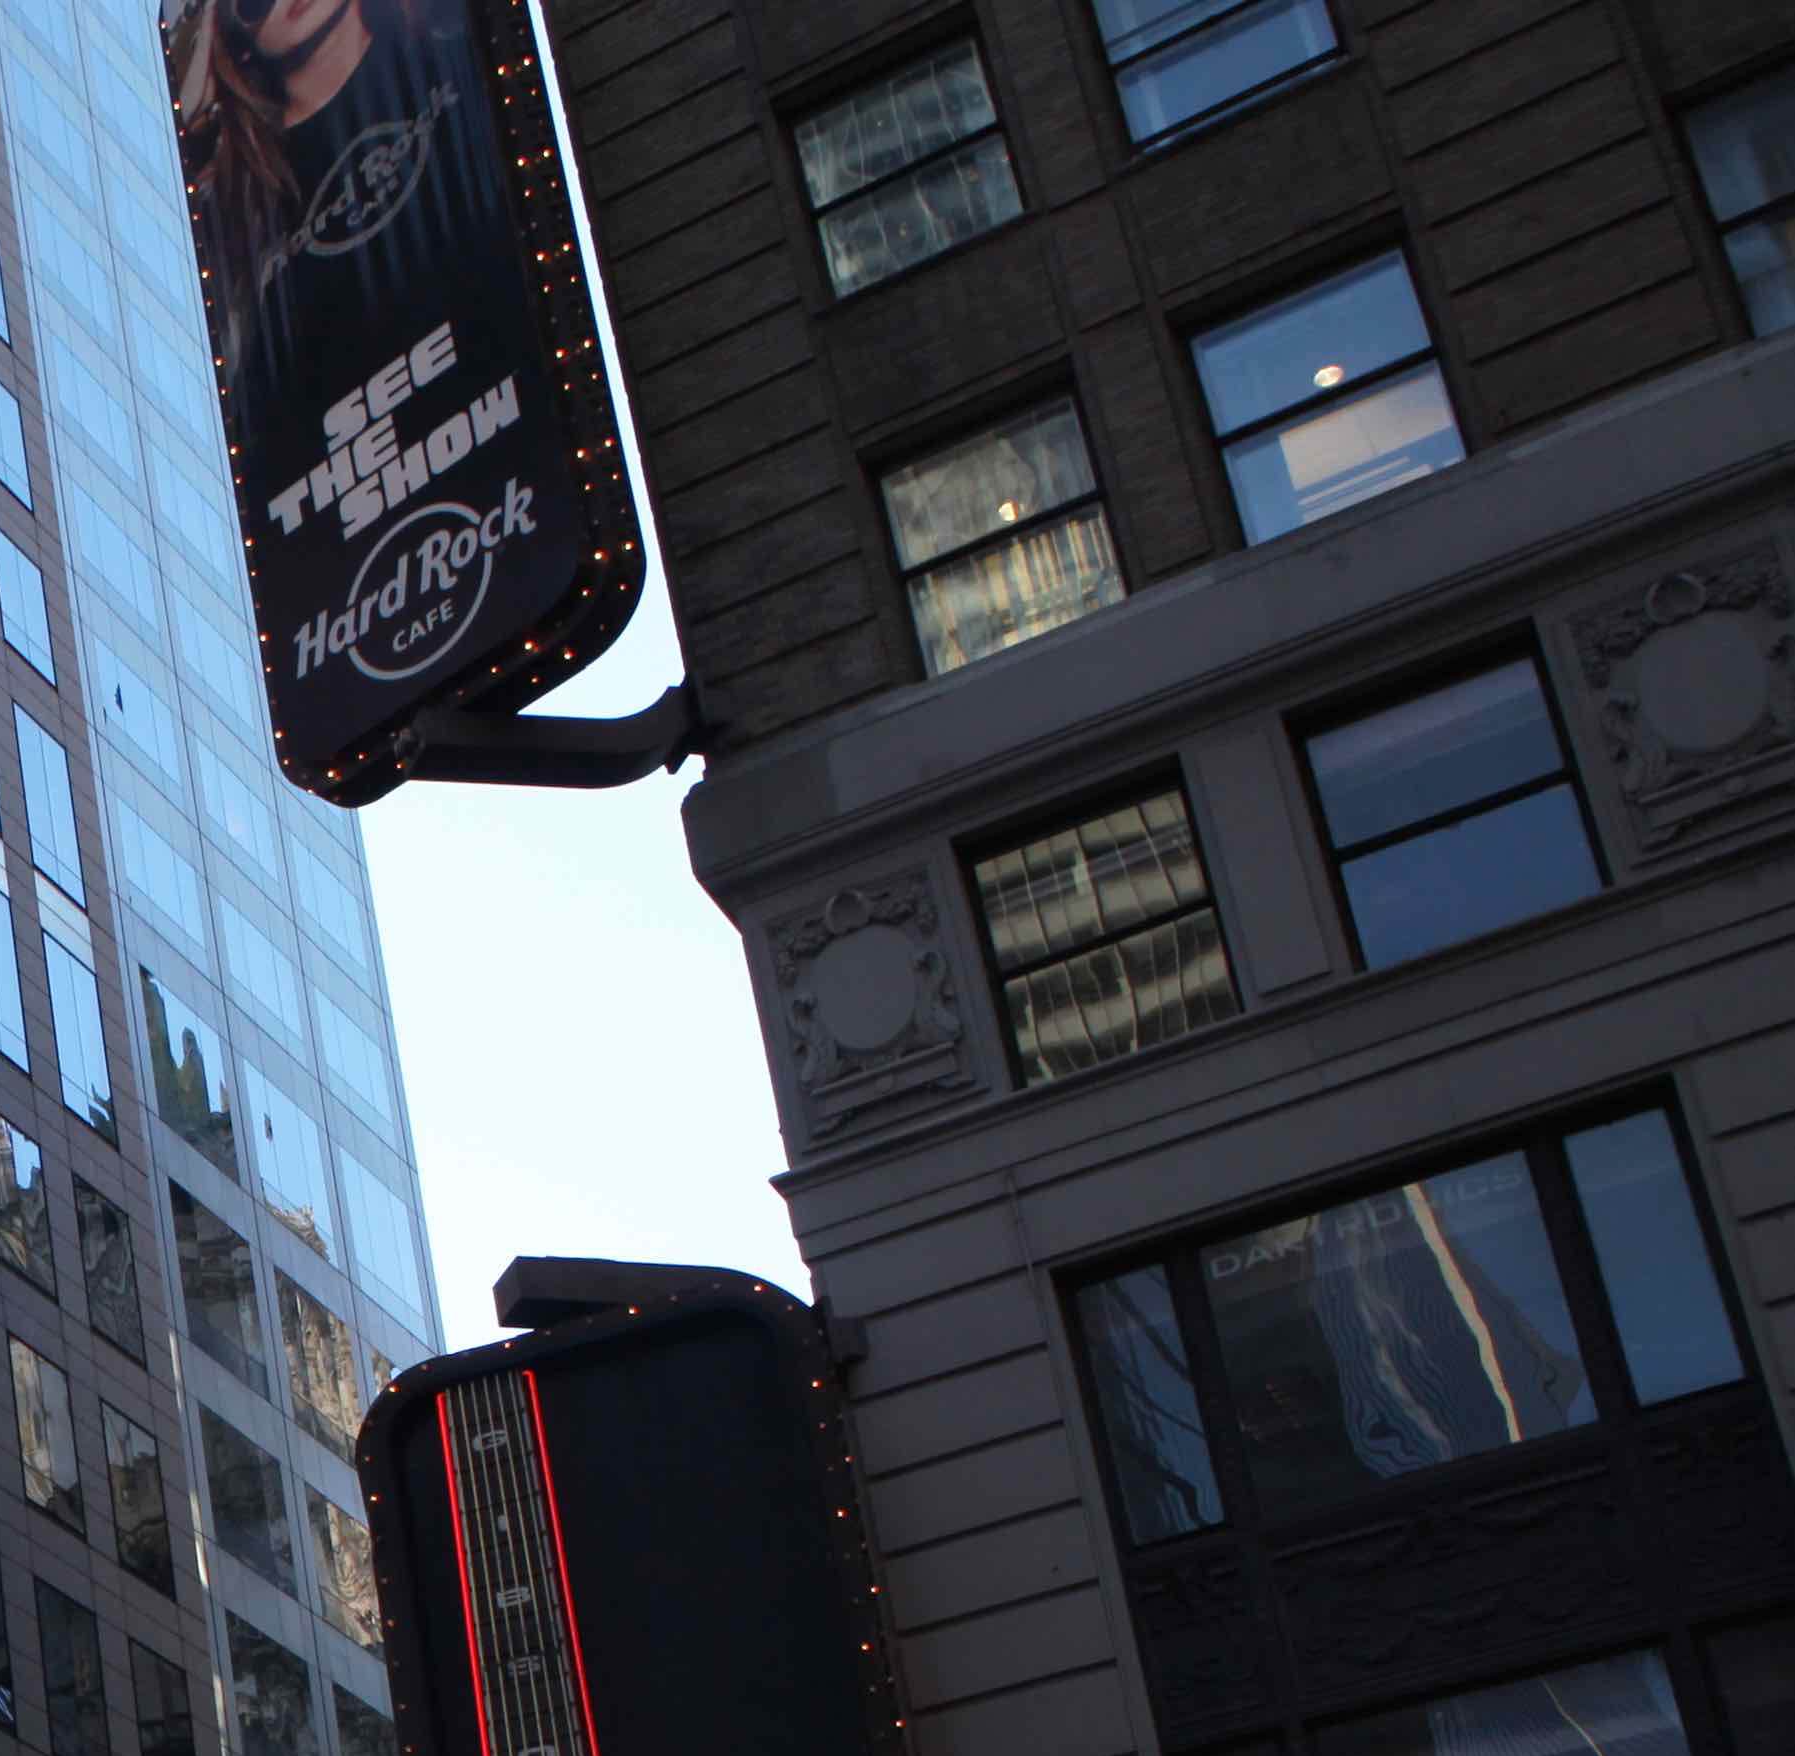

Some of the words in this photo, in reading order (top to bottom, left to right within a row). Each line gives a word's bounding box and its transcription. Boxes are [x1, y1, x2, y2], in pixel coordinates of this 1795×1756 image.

[324, 321, 457, 453] SEE
[267, 414, 399, 535] THE
[339, 376, 521, 541] SHOW
[294, 553, 408, 681] Hard
[417, 477, 537, 594] Rock
[392, 598, 455, 652] CAFE
